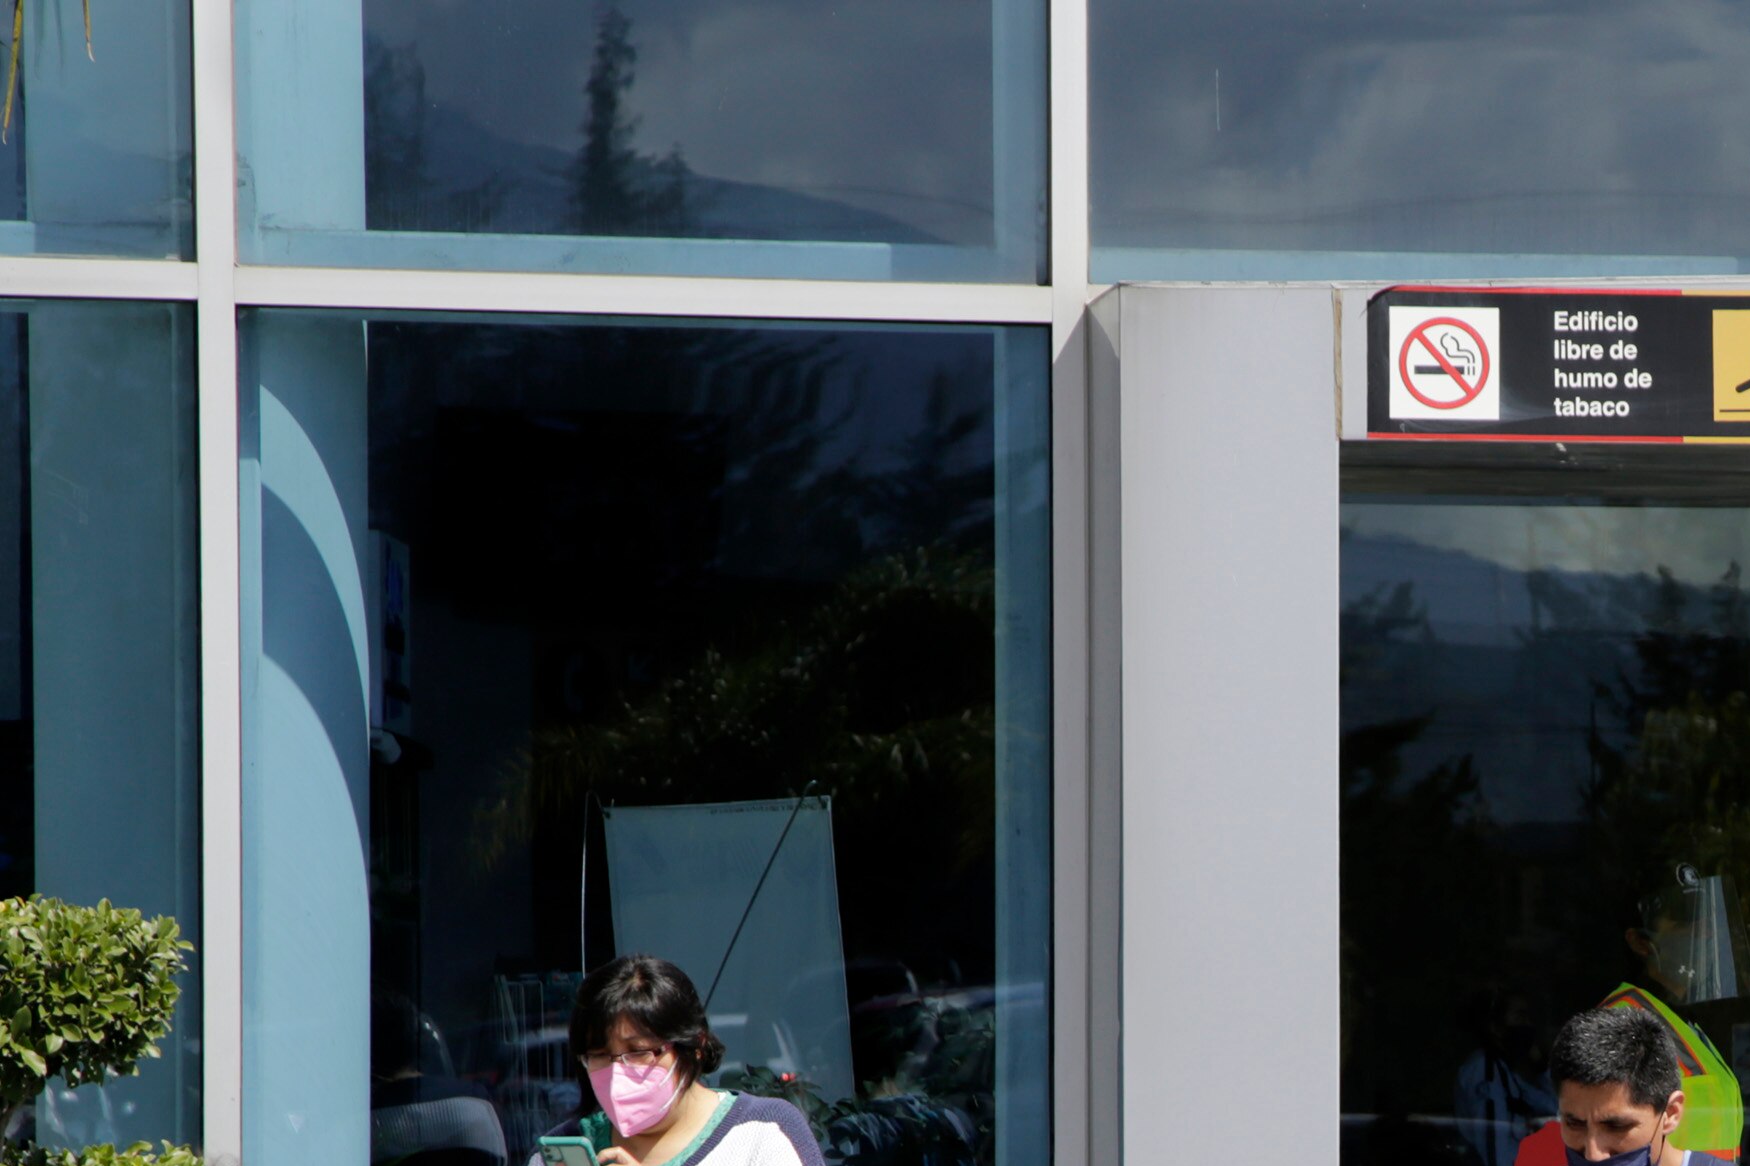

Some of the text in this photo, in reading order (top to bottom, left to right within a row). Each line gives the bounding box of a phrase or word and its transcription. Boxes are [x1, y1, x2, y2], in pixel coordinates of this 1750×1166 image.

[1554, 310, 1639, 332] Edificio
[1554, 339, 1638, 360] libre de
[1554, 368, 1653, 389] humo de
[1553, 396, 1630, 417] tabaco
